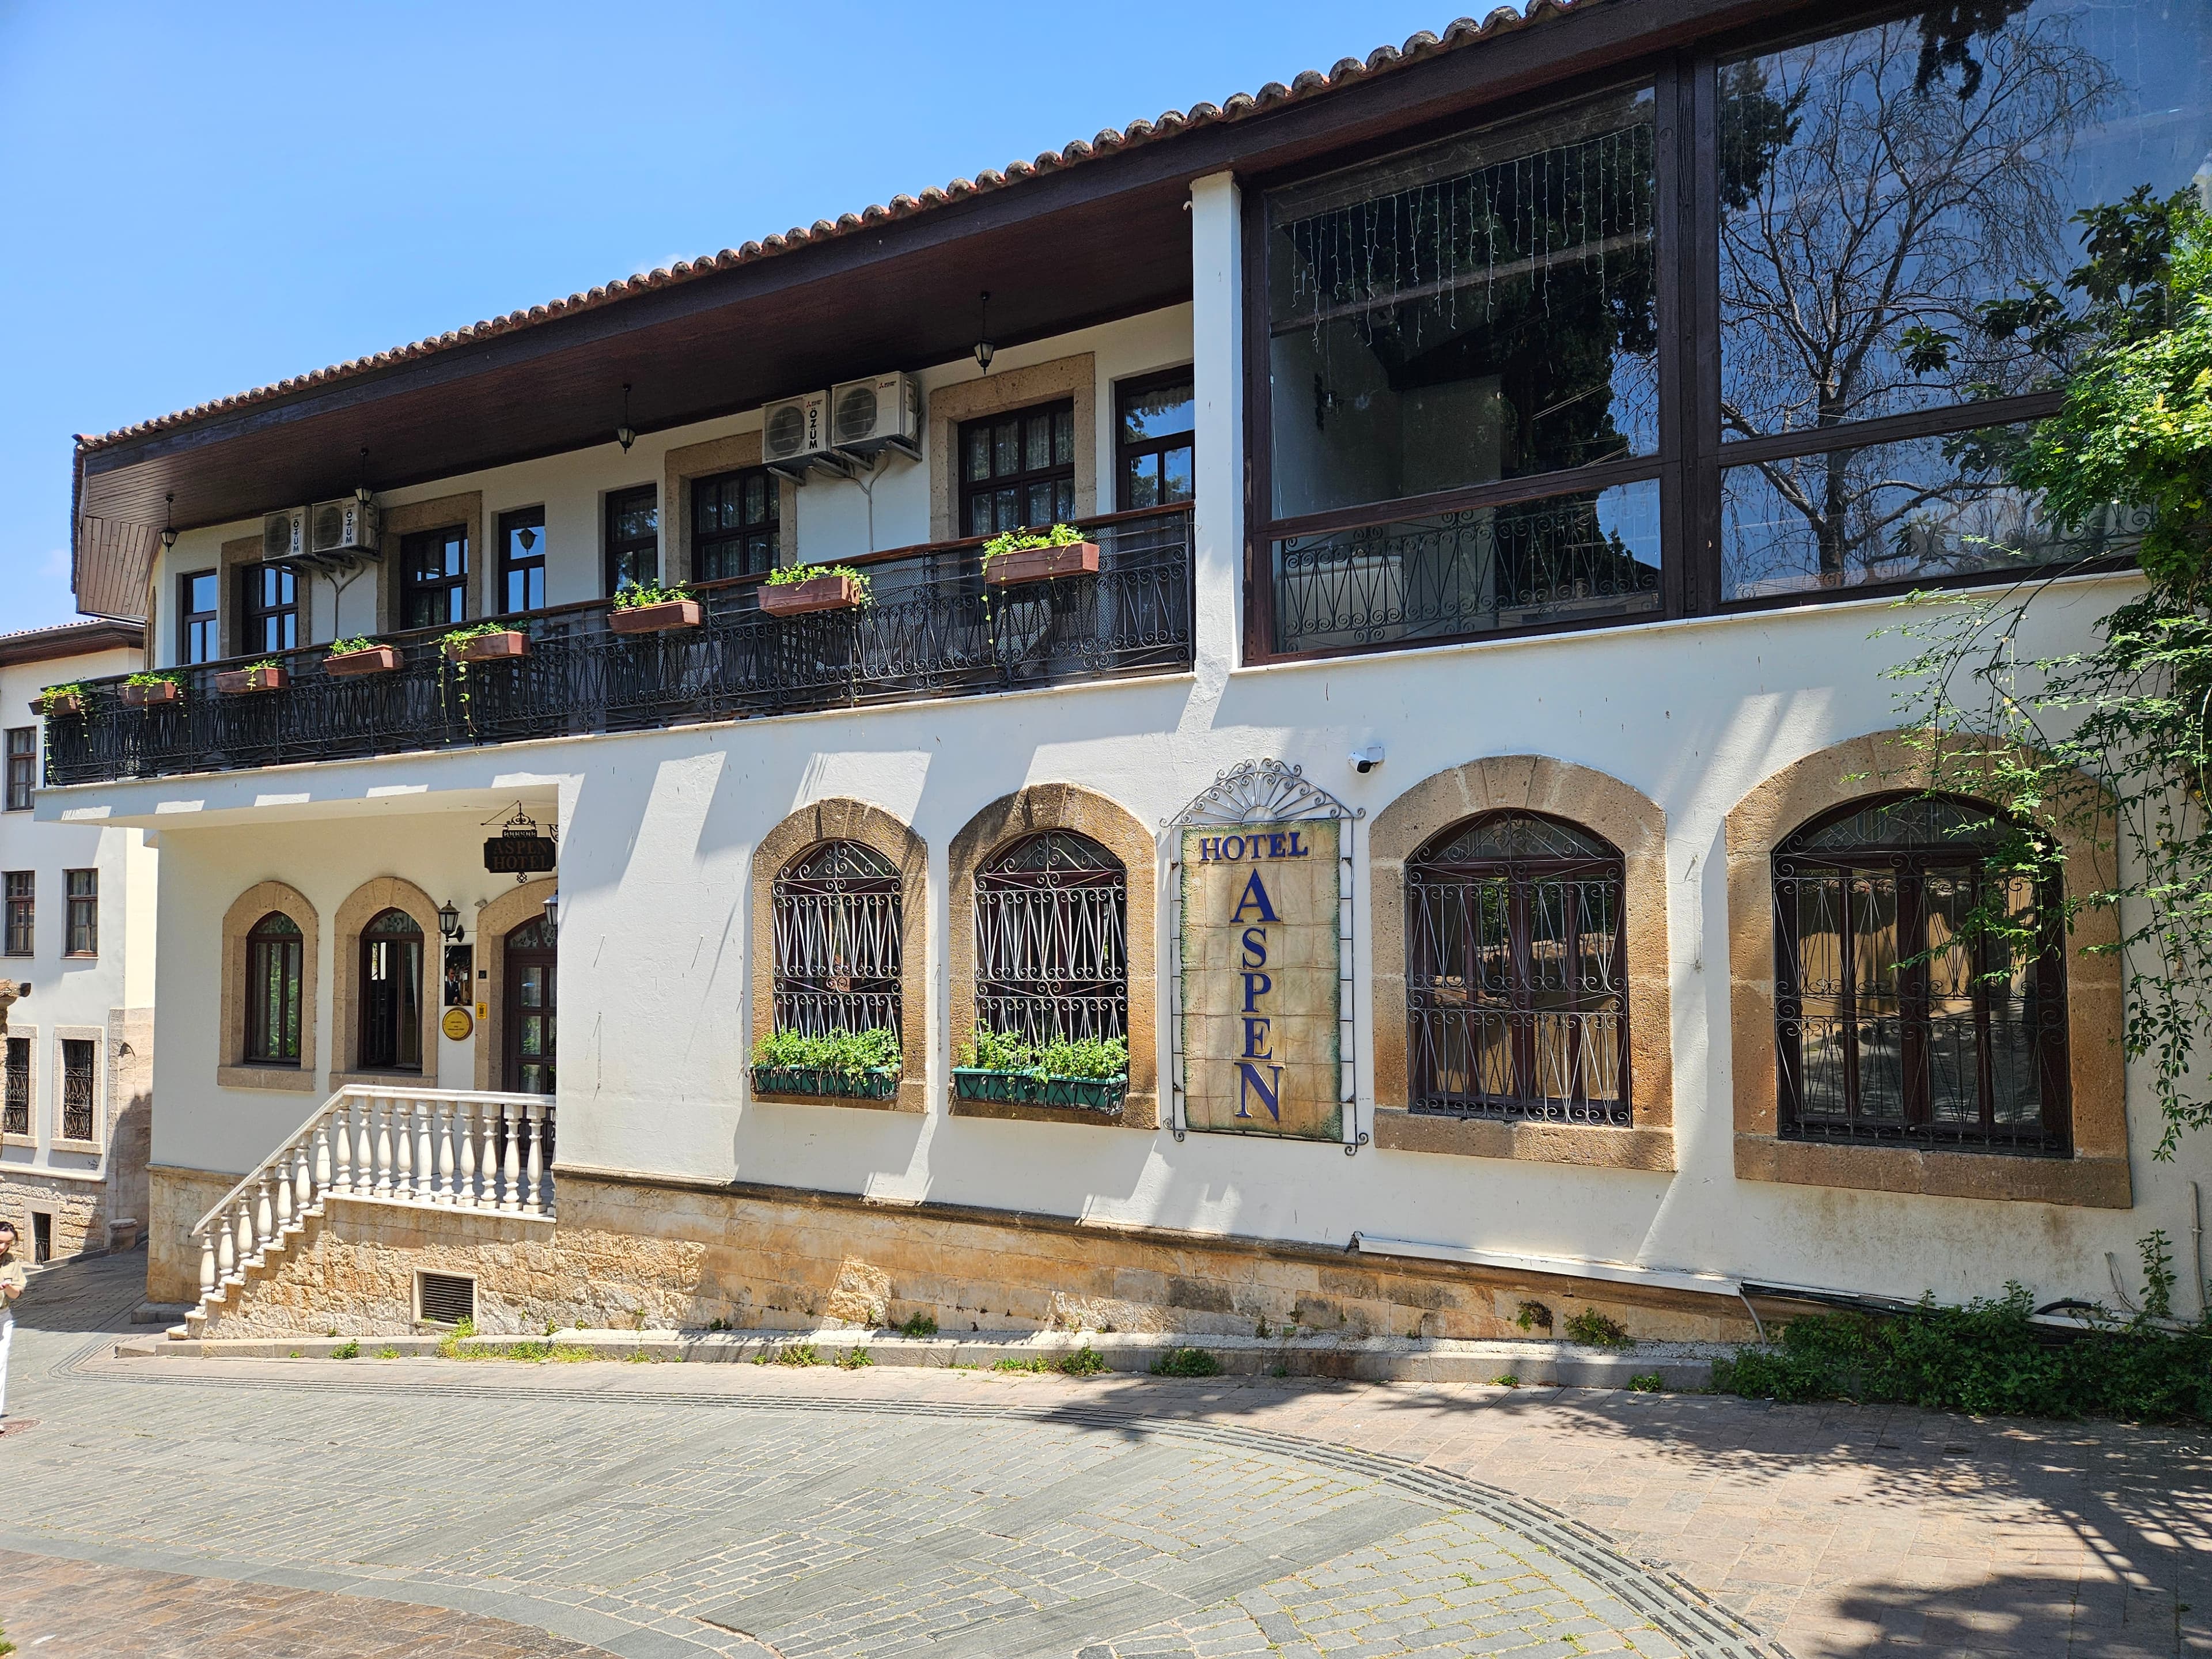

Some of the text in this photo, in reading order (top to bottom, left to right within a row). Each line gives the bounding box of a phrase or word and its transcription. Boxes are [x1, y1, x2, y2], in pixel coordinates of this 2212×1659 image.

[809, 407, 817, 449] ÖZÜM
[494, 841, 548, 854] ASPEN
[1200, 832, 1308, 860] HOTEL
[494, 855, 549, 869] HOTEL
[1231, 868, 1285, 1122] ASPEN
